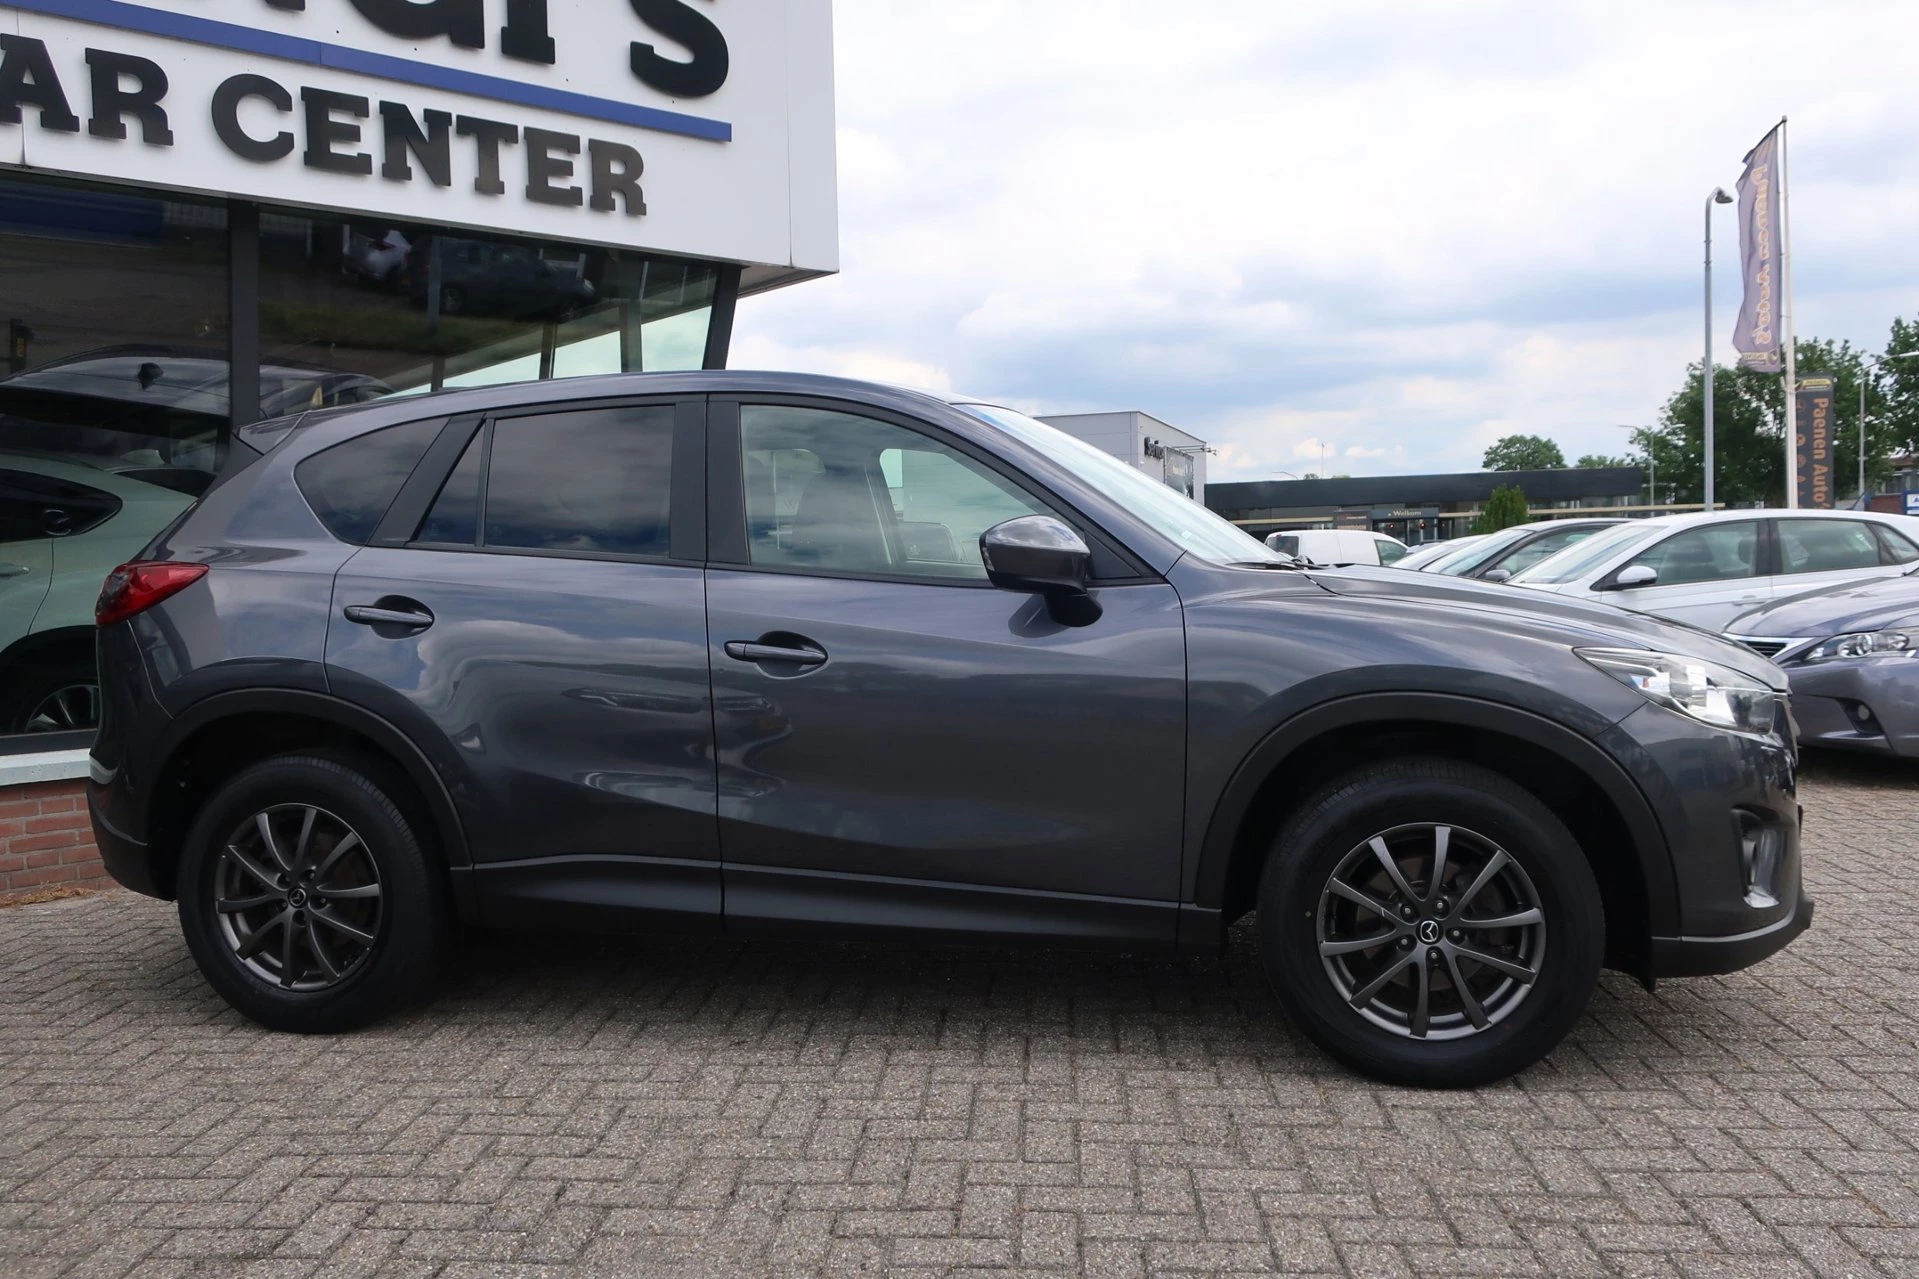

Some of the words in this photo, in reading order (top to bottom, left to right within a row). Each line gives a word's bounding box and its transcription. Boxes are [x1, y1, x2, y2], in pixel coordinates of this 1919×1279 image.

[212, 73, 647, 217] CENTER
[1813, 398, 1829, 459] Paenen
[1813, 464, 1831, 508] Auto'
[1393, 509, 1421, 517] Welkom
